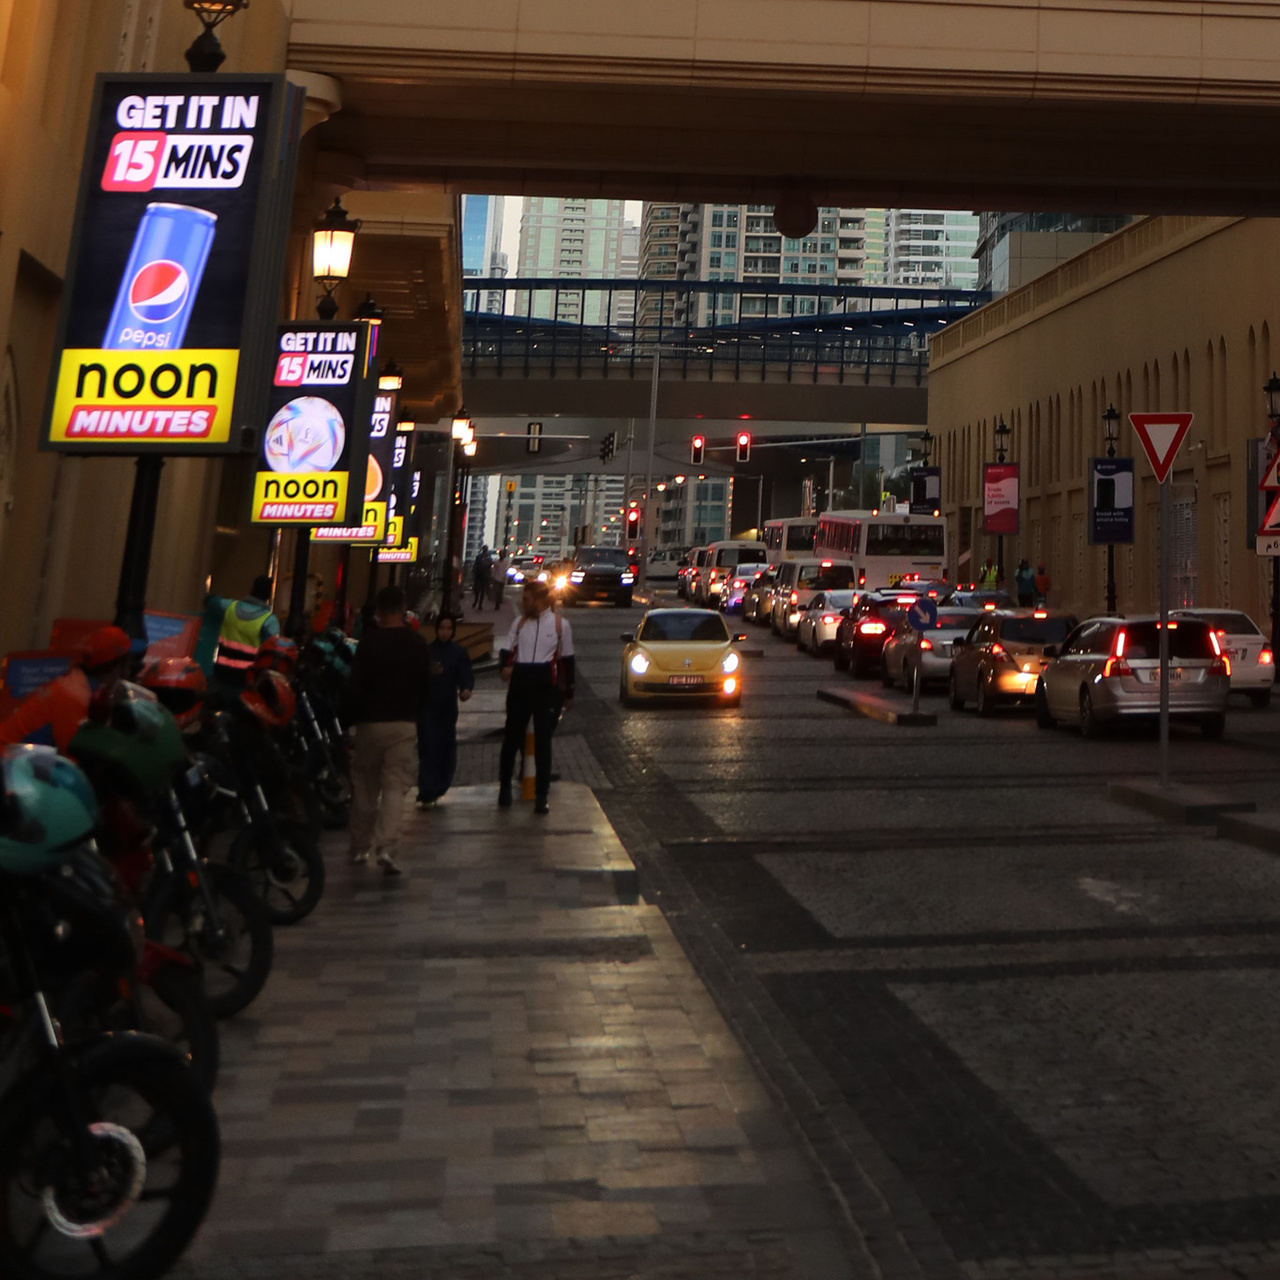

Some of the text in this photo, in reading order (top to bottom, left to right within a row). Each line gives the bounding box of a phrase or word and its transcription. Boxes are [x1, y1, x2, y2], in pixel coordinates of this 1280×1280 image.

[116, 95, 259, 129] GET IT IN
[111, 139, 245, 183] 15 MINS
[119, 327, 172, 348] pepsi
[280, 332, 357, 352] GET IT IN
[76, 362, 218, 399] noon
[279, 356, 349, 382] 15 MINS
[71, 410, 211, 435] MINUTES
[264, 478, 338, 499] noon
[262, 504, 336, 518] MINUTES
[316, 526, 375, 538] MINUTES
